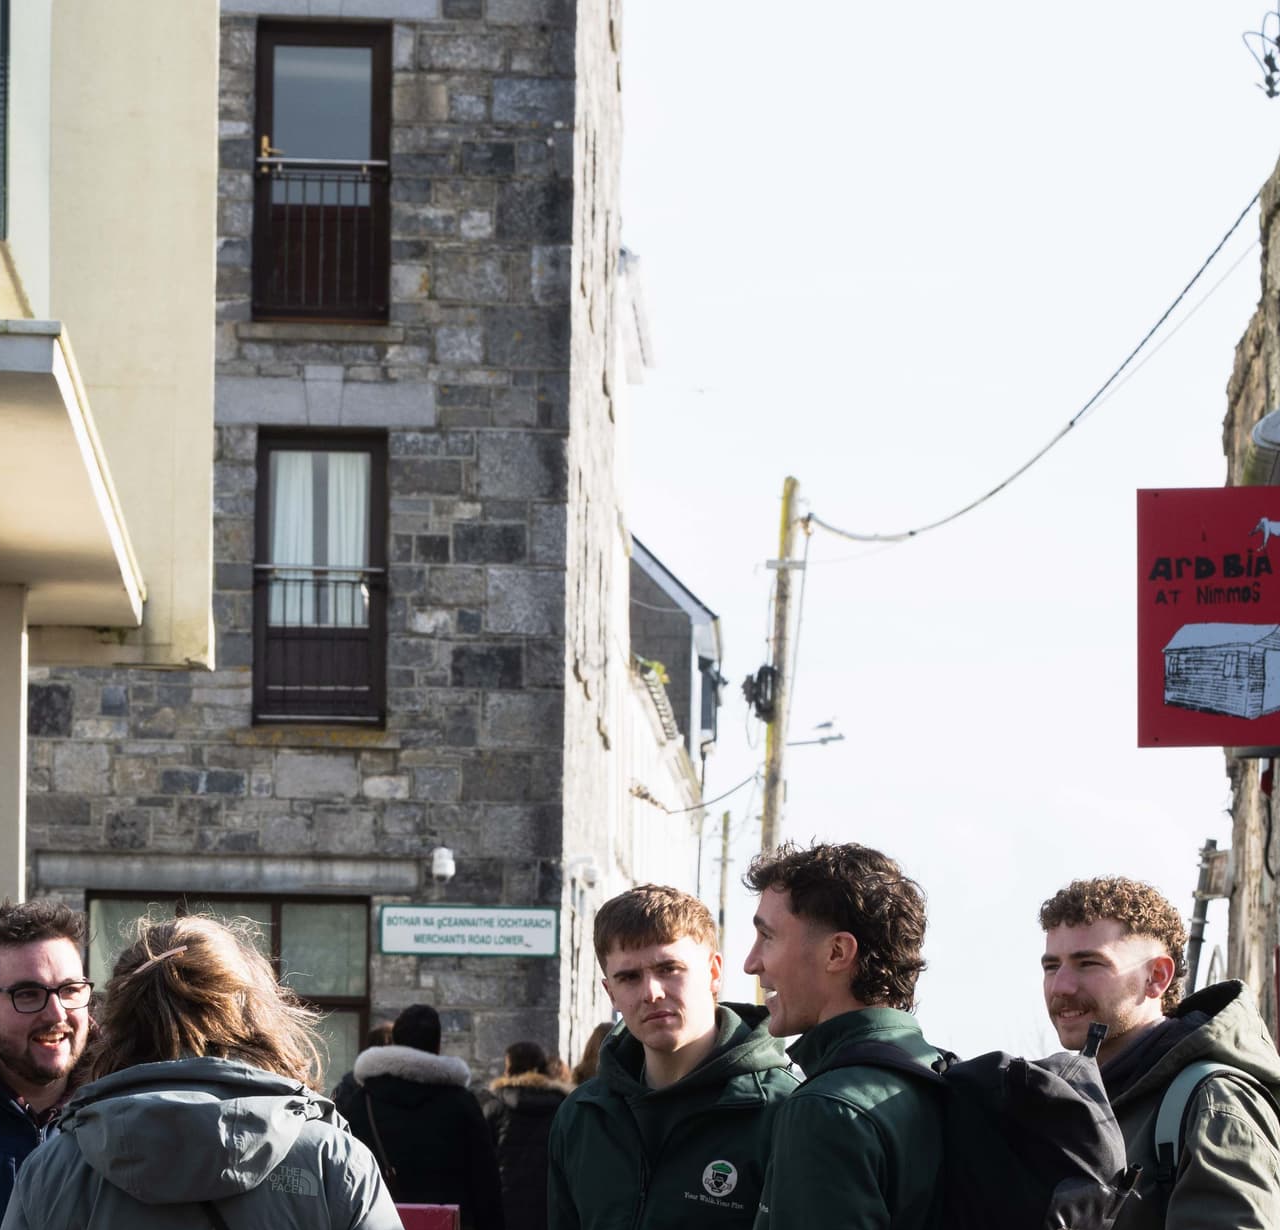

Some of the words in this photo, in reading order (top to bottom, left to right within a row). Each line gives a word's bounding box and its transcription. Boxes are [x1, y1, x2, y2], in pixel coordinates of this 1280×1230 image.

[1154, 589, 1181, 605] AT
[423, 916, 435, 927] NA
[414, 933, 466, 944] MERCHANTS
[469, 934, 492, 944] ROAD
[494, 935, 524, 945] LOWER
[280, 1165, 300, 1177] THE
[266, 1173, 299, 1188] ORTH
[271, 1182, 299, 1194] FACE
